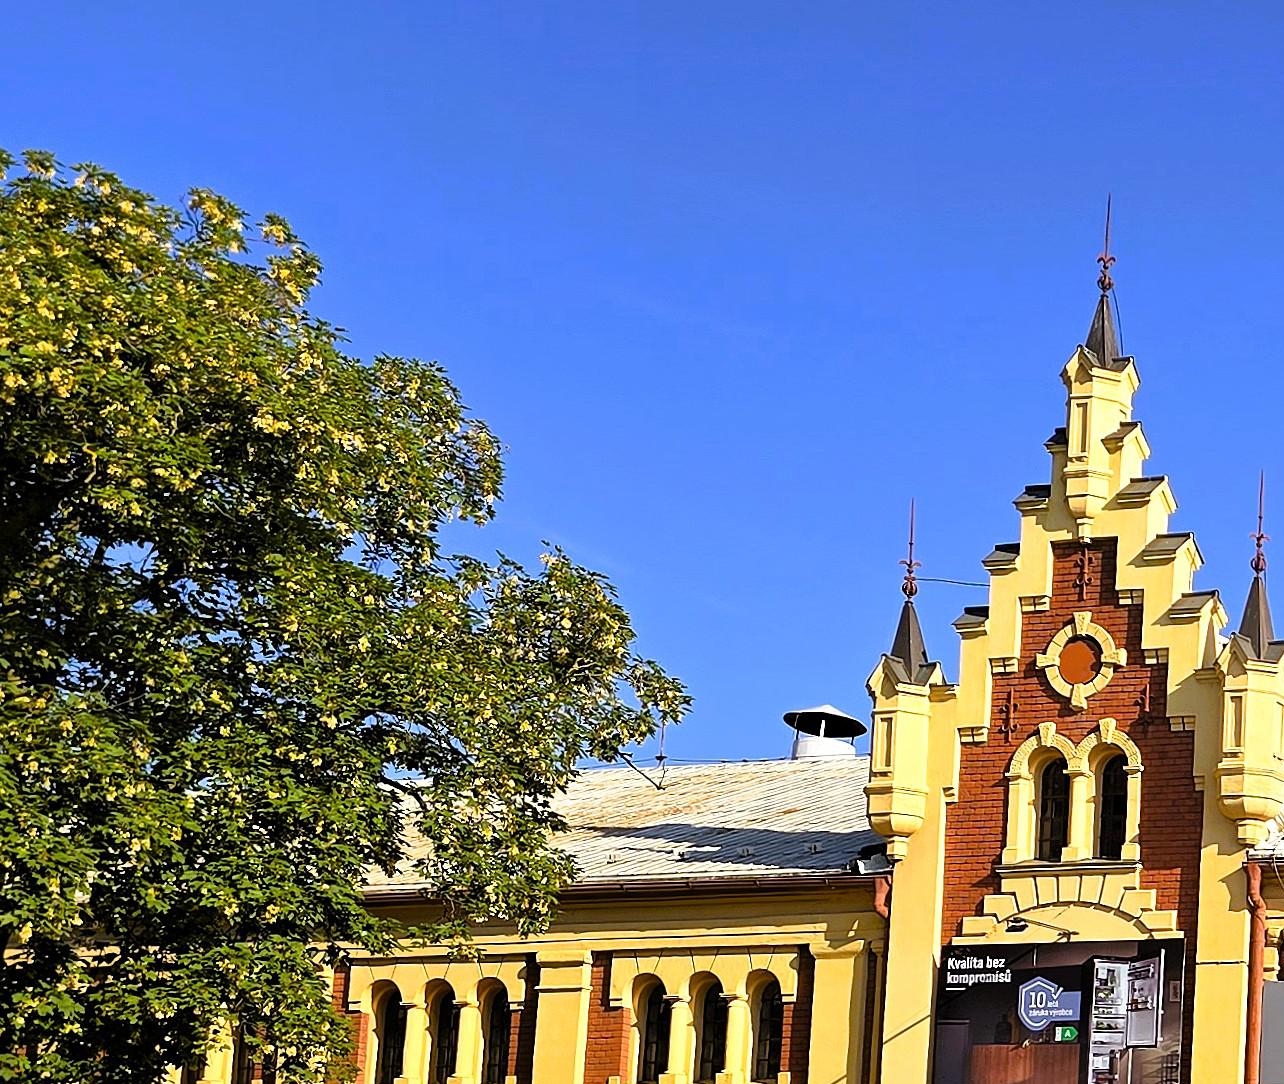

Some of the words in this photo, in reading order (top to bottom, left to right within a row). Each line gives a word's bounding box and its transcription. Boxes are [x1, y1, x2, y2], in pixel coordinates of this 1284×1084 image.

[947, 956, 984, 970] Kvalita
[986, 955, 1006, 969] bez
[946, 968, 1012, 986] kompromisů
[1028, 991, 1047, 1008] 10
[1064, 1029, 1072, 1038] A
